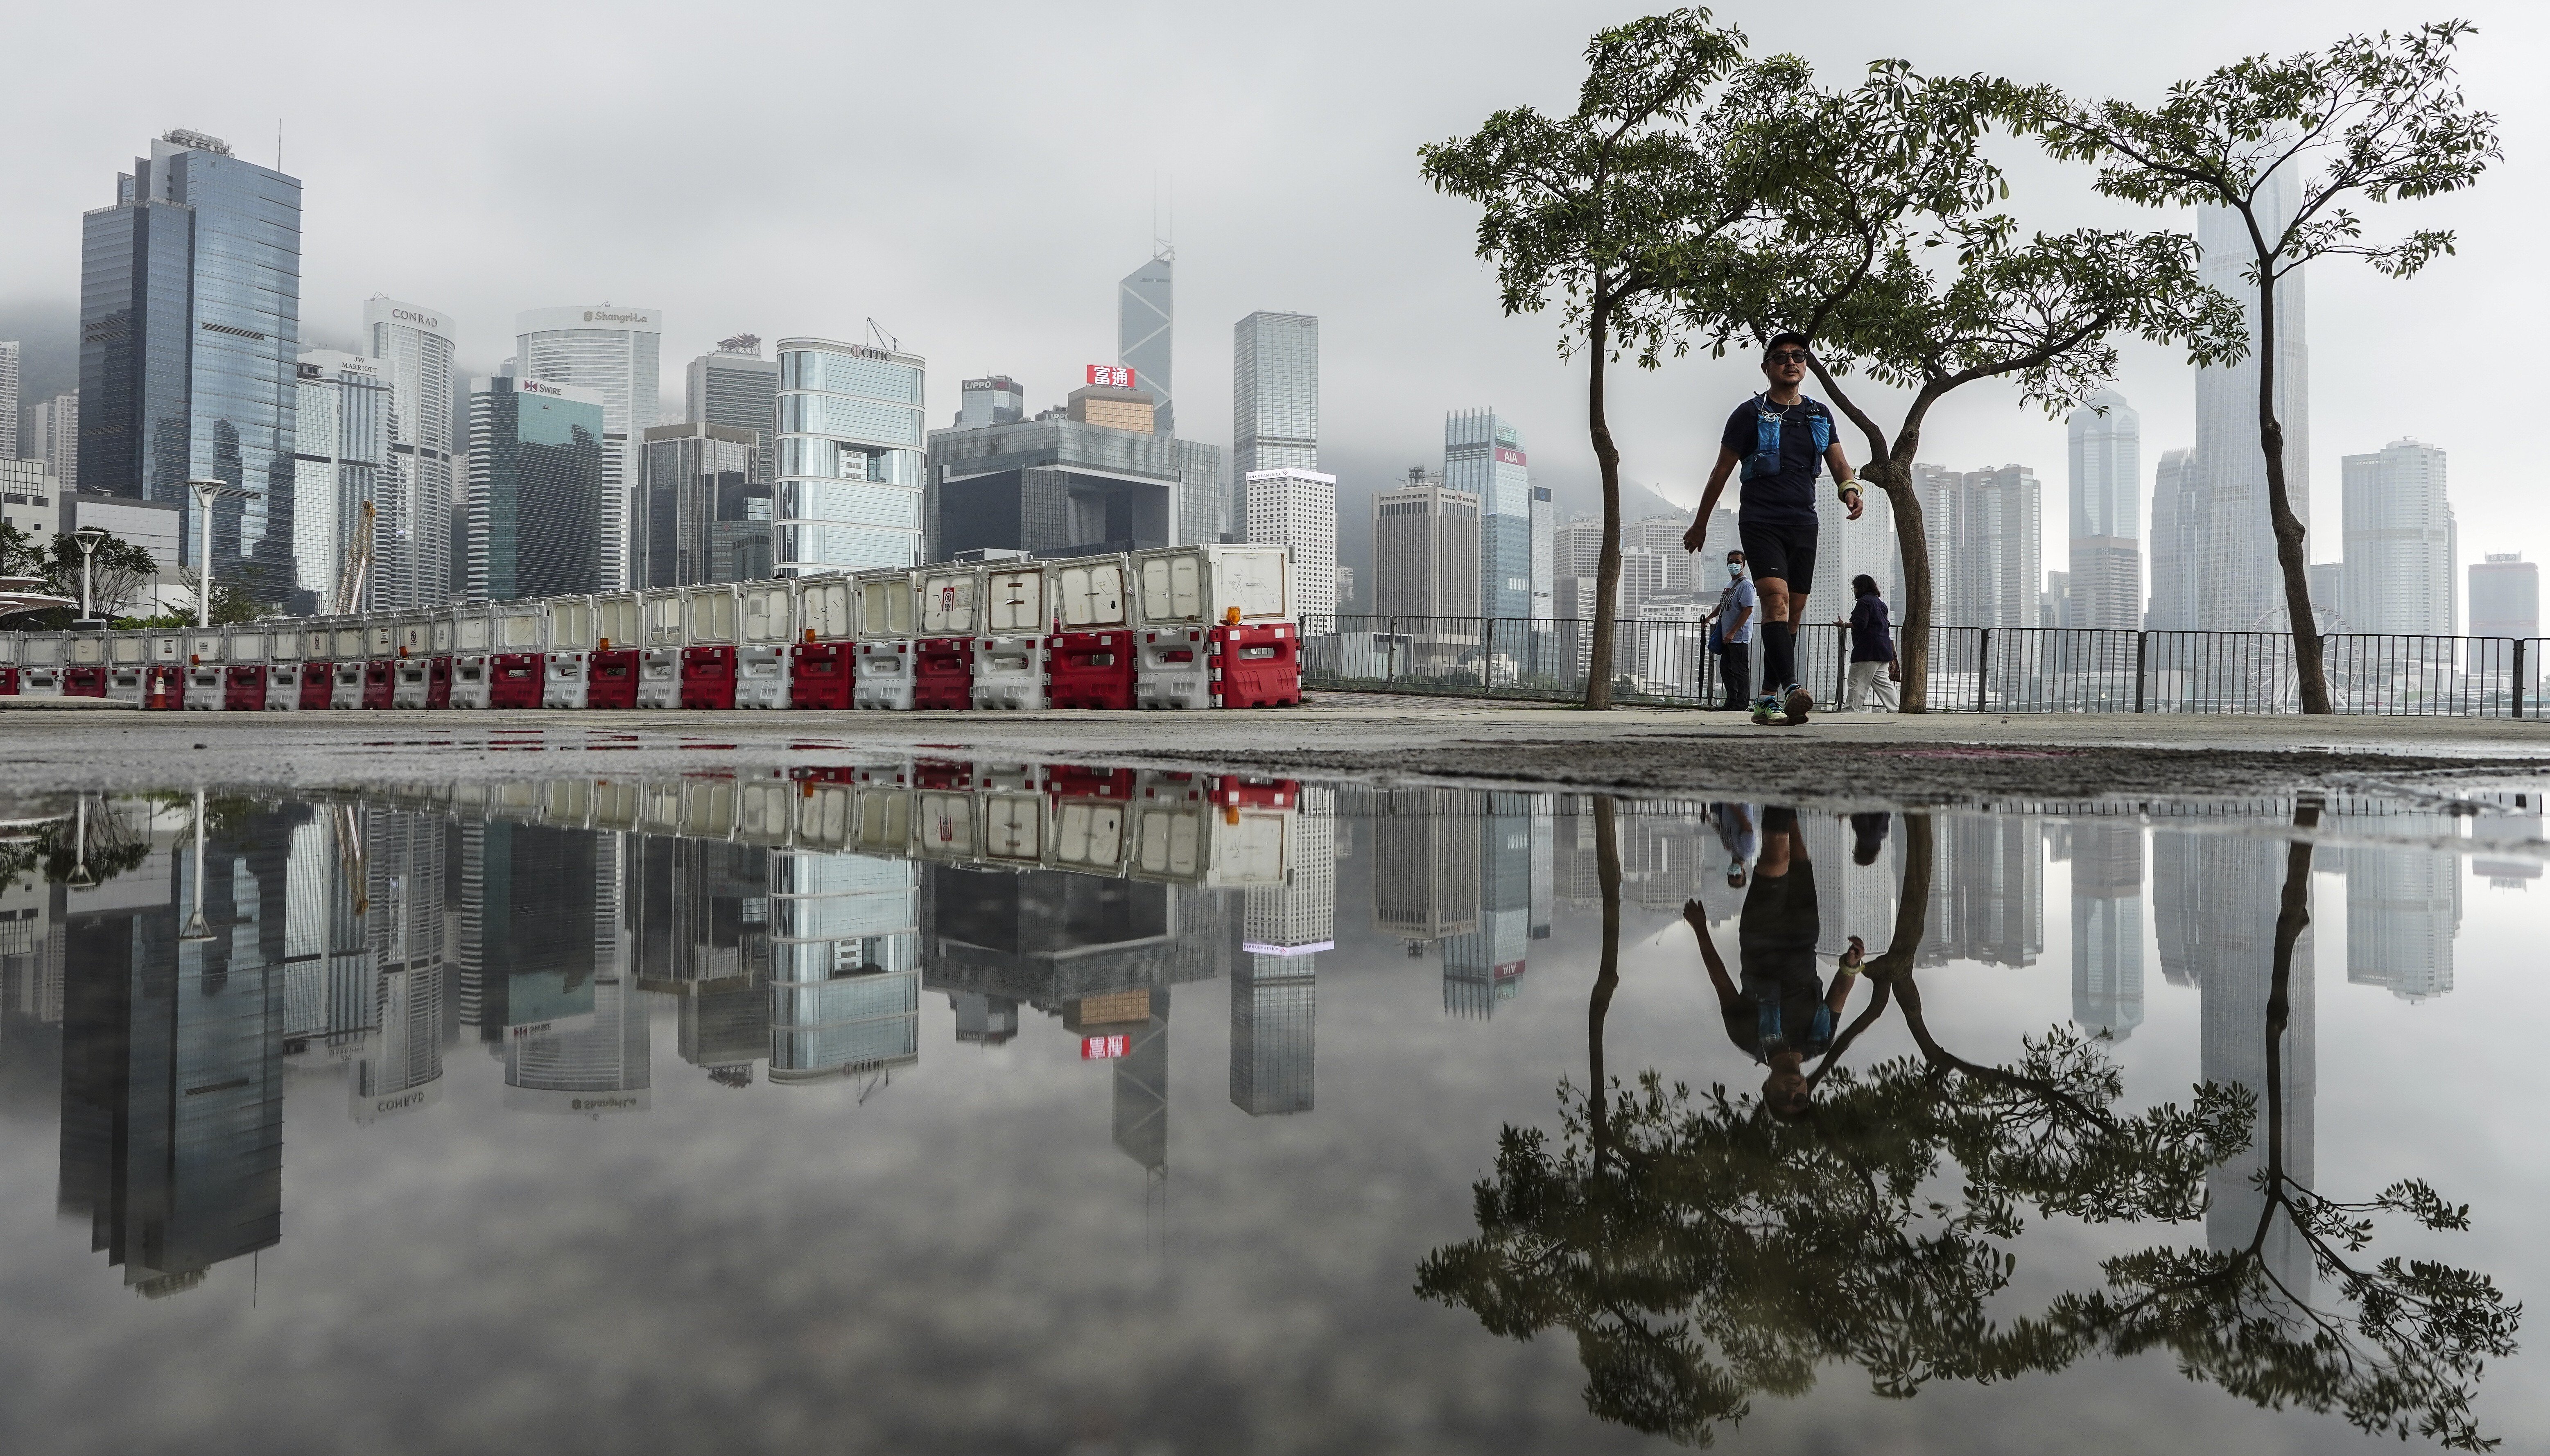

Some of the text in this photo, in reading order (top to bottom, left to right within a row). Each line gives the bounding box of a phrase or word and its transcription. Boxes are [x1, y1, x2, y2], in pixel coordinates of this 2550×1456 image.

[393, 309, 437, 327] CONRAD
[595, 311, 647, 323] Shangri-La
[862, 348, 891, 361] CITIC
[341, 362, 377, 373] MARRIOTT
[1094, 366, 1128, 387] 富通
[964, 381, 991, 389] LIPPO
[1504, 451, 1518, 463] AIA
